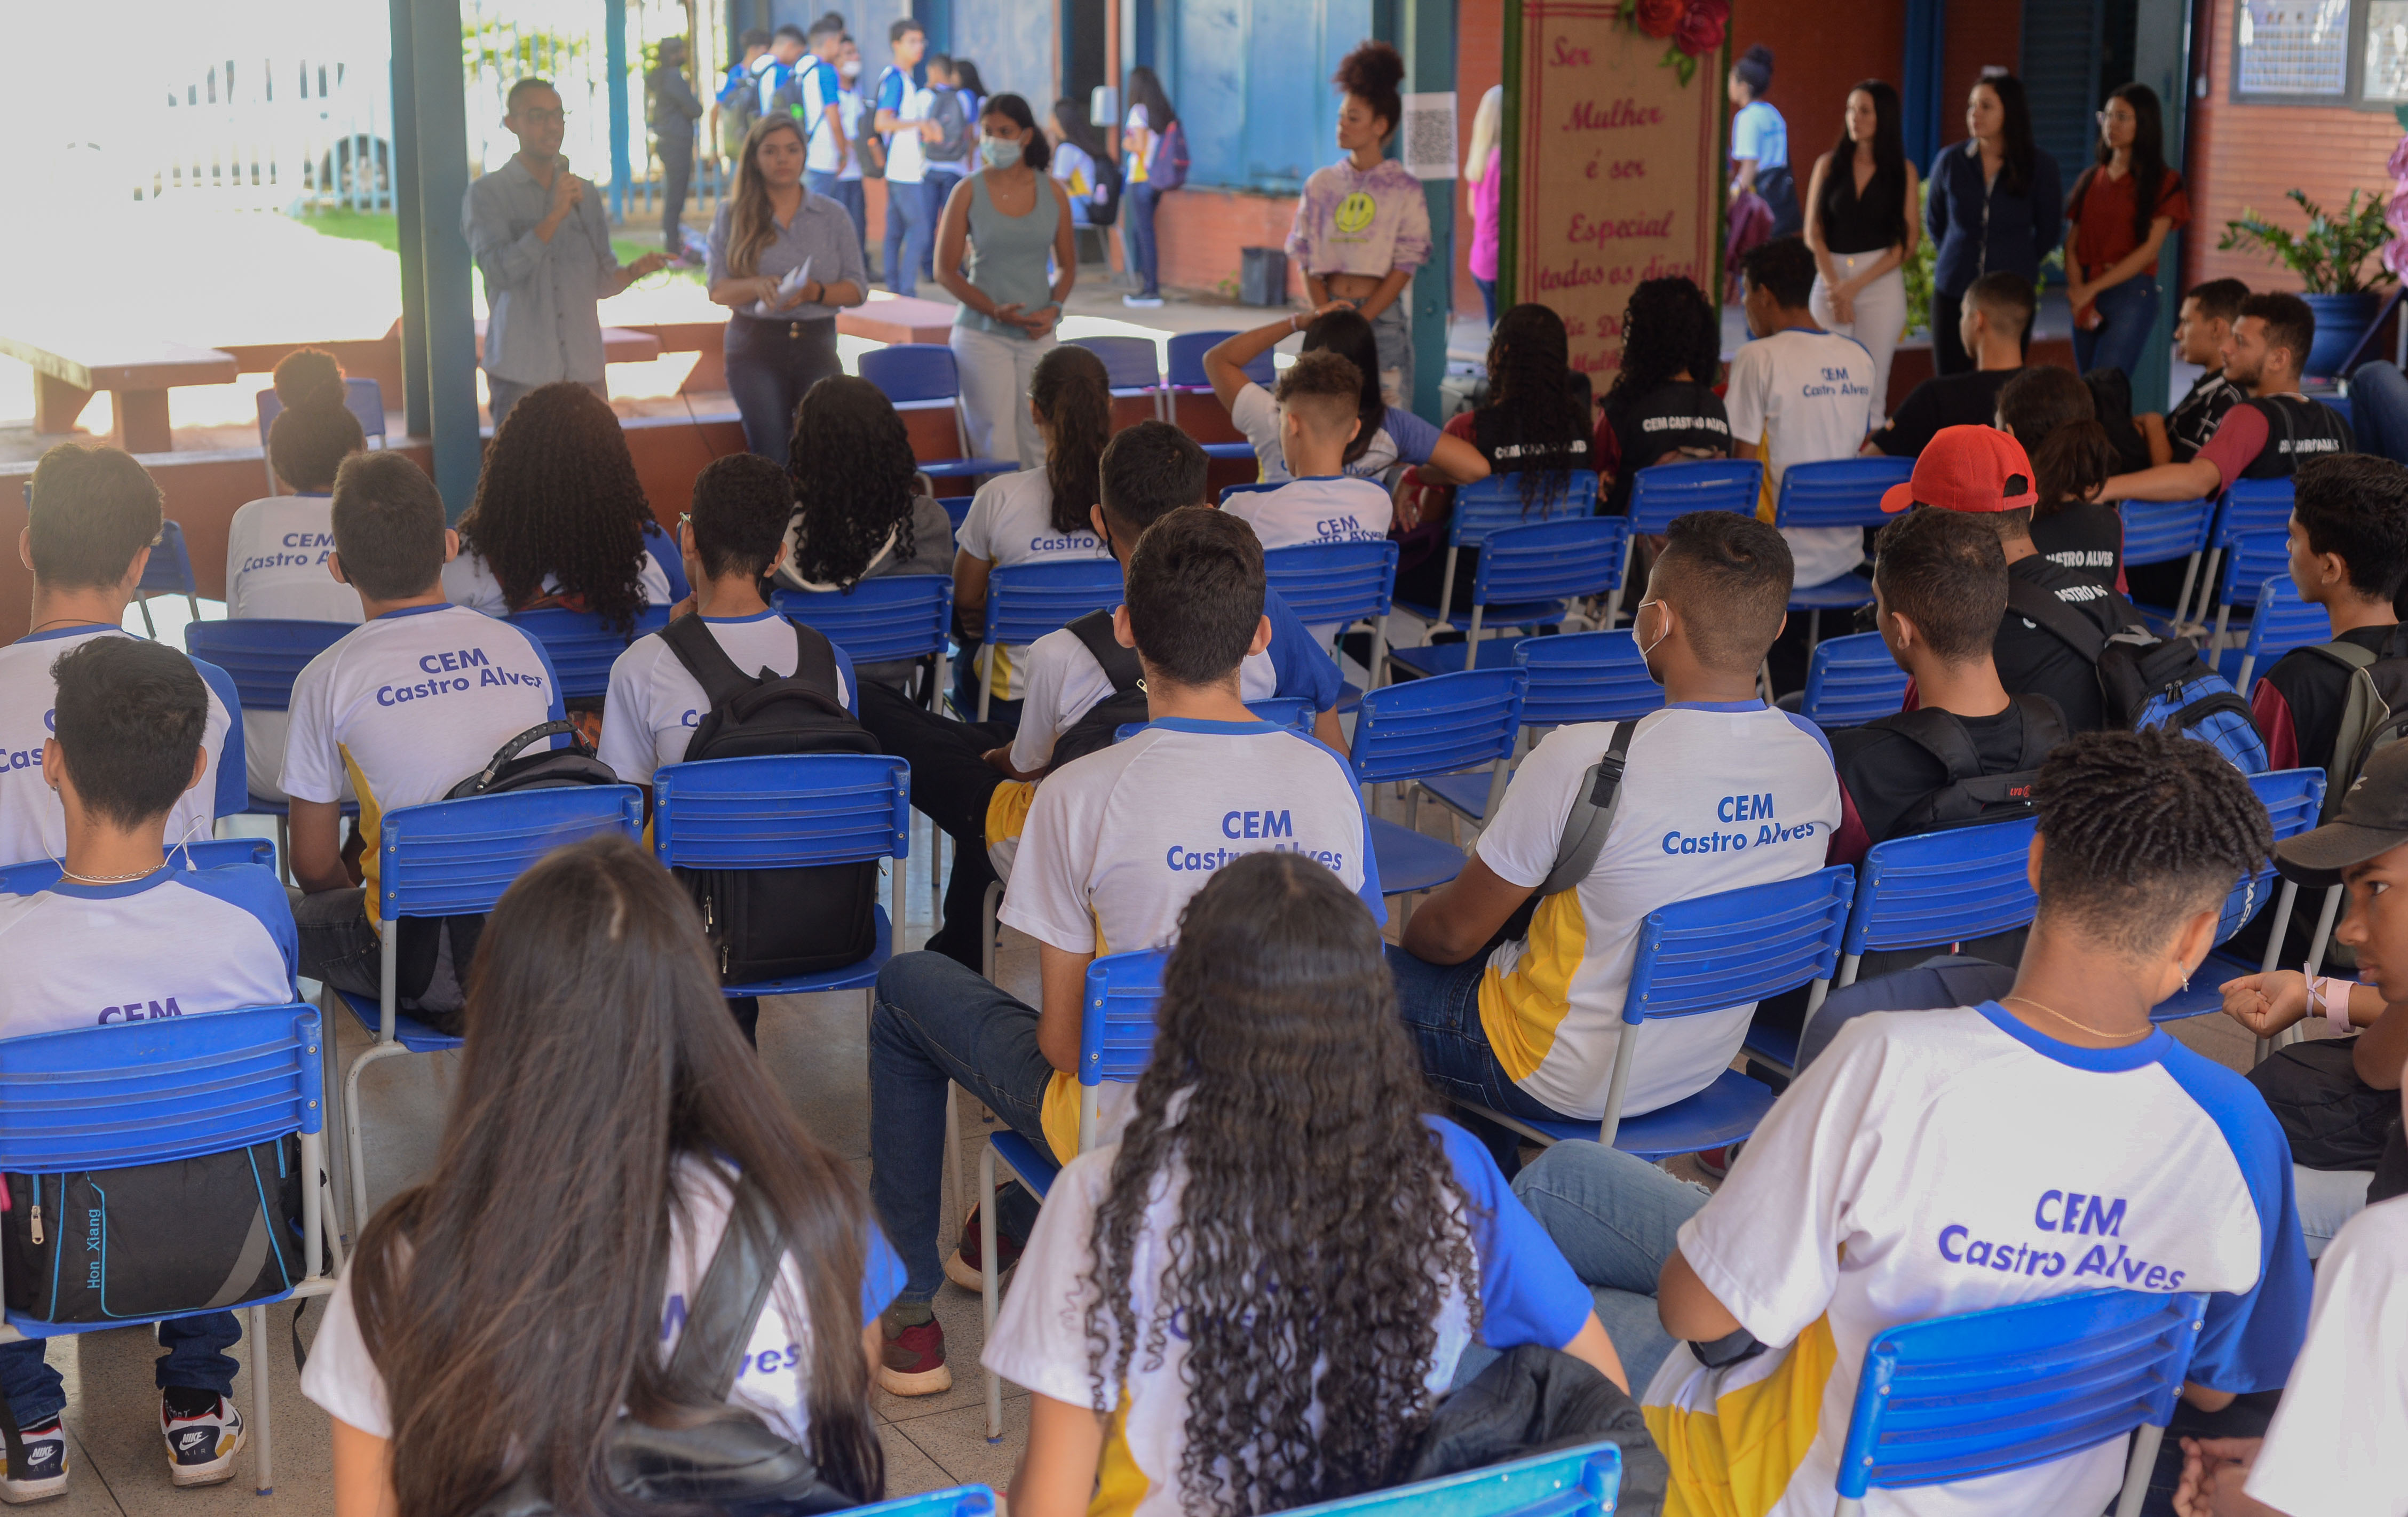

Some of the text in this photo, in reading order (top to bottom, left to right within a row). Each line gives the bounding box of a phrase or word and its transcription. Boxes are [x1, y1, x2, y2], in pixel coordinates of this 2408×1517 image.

[1549, 36, 1592, 66] Ser
[1562, 98, 1666, 131] Mulher
[1610, 160, 1646, 179] ser
[1568, 210, 1674, 250] Especial
[1540, 258, 1604, 290] todos
[1609, 267, 1633, 285] os
[1821, 367, 1849, 381] CEM
[1317, 514, 1360, 536] CEM
[282, 533, 335, 547] CEM
[1030, 534, 1094, 551] Castro
[242, 552, 308, 572] Castro
[2086, 551, 2113, 567] ALVES
[419, 648, 489, 674] CEM
[376, 667, 543, 706] Castro Alves
[1717, 793, 1773, 823] CEM
[1222, 810, 1293, 839] CEM
[1662, 822, 1814, 855] Castro Alves
[98, 997, 182, 1025] CEM
[2035, 1189, 2128, 1237] CEM
[1938, 1225, 2186, 1291] Castro Alves
[183, 1431, 203, 1443] NIKE
[32, 1445, 53, 1458] NIKE
[185, 1448, 205, 1456] AIR
